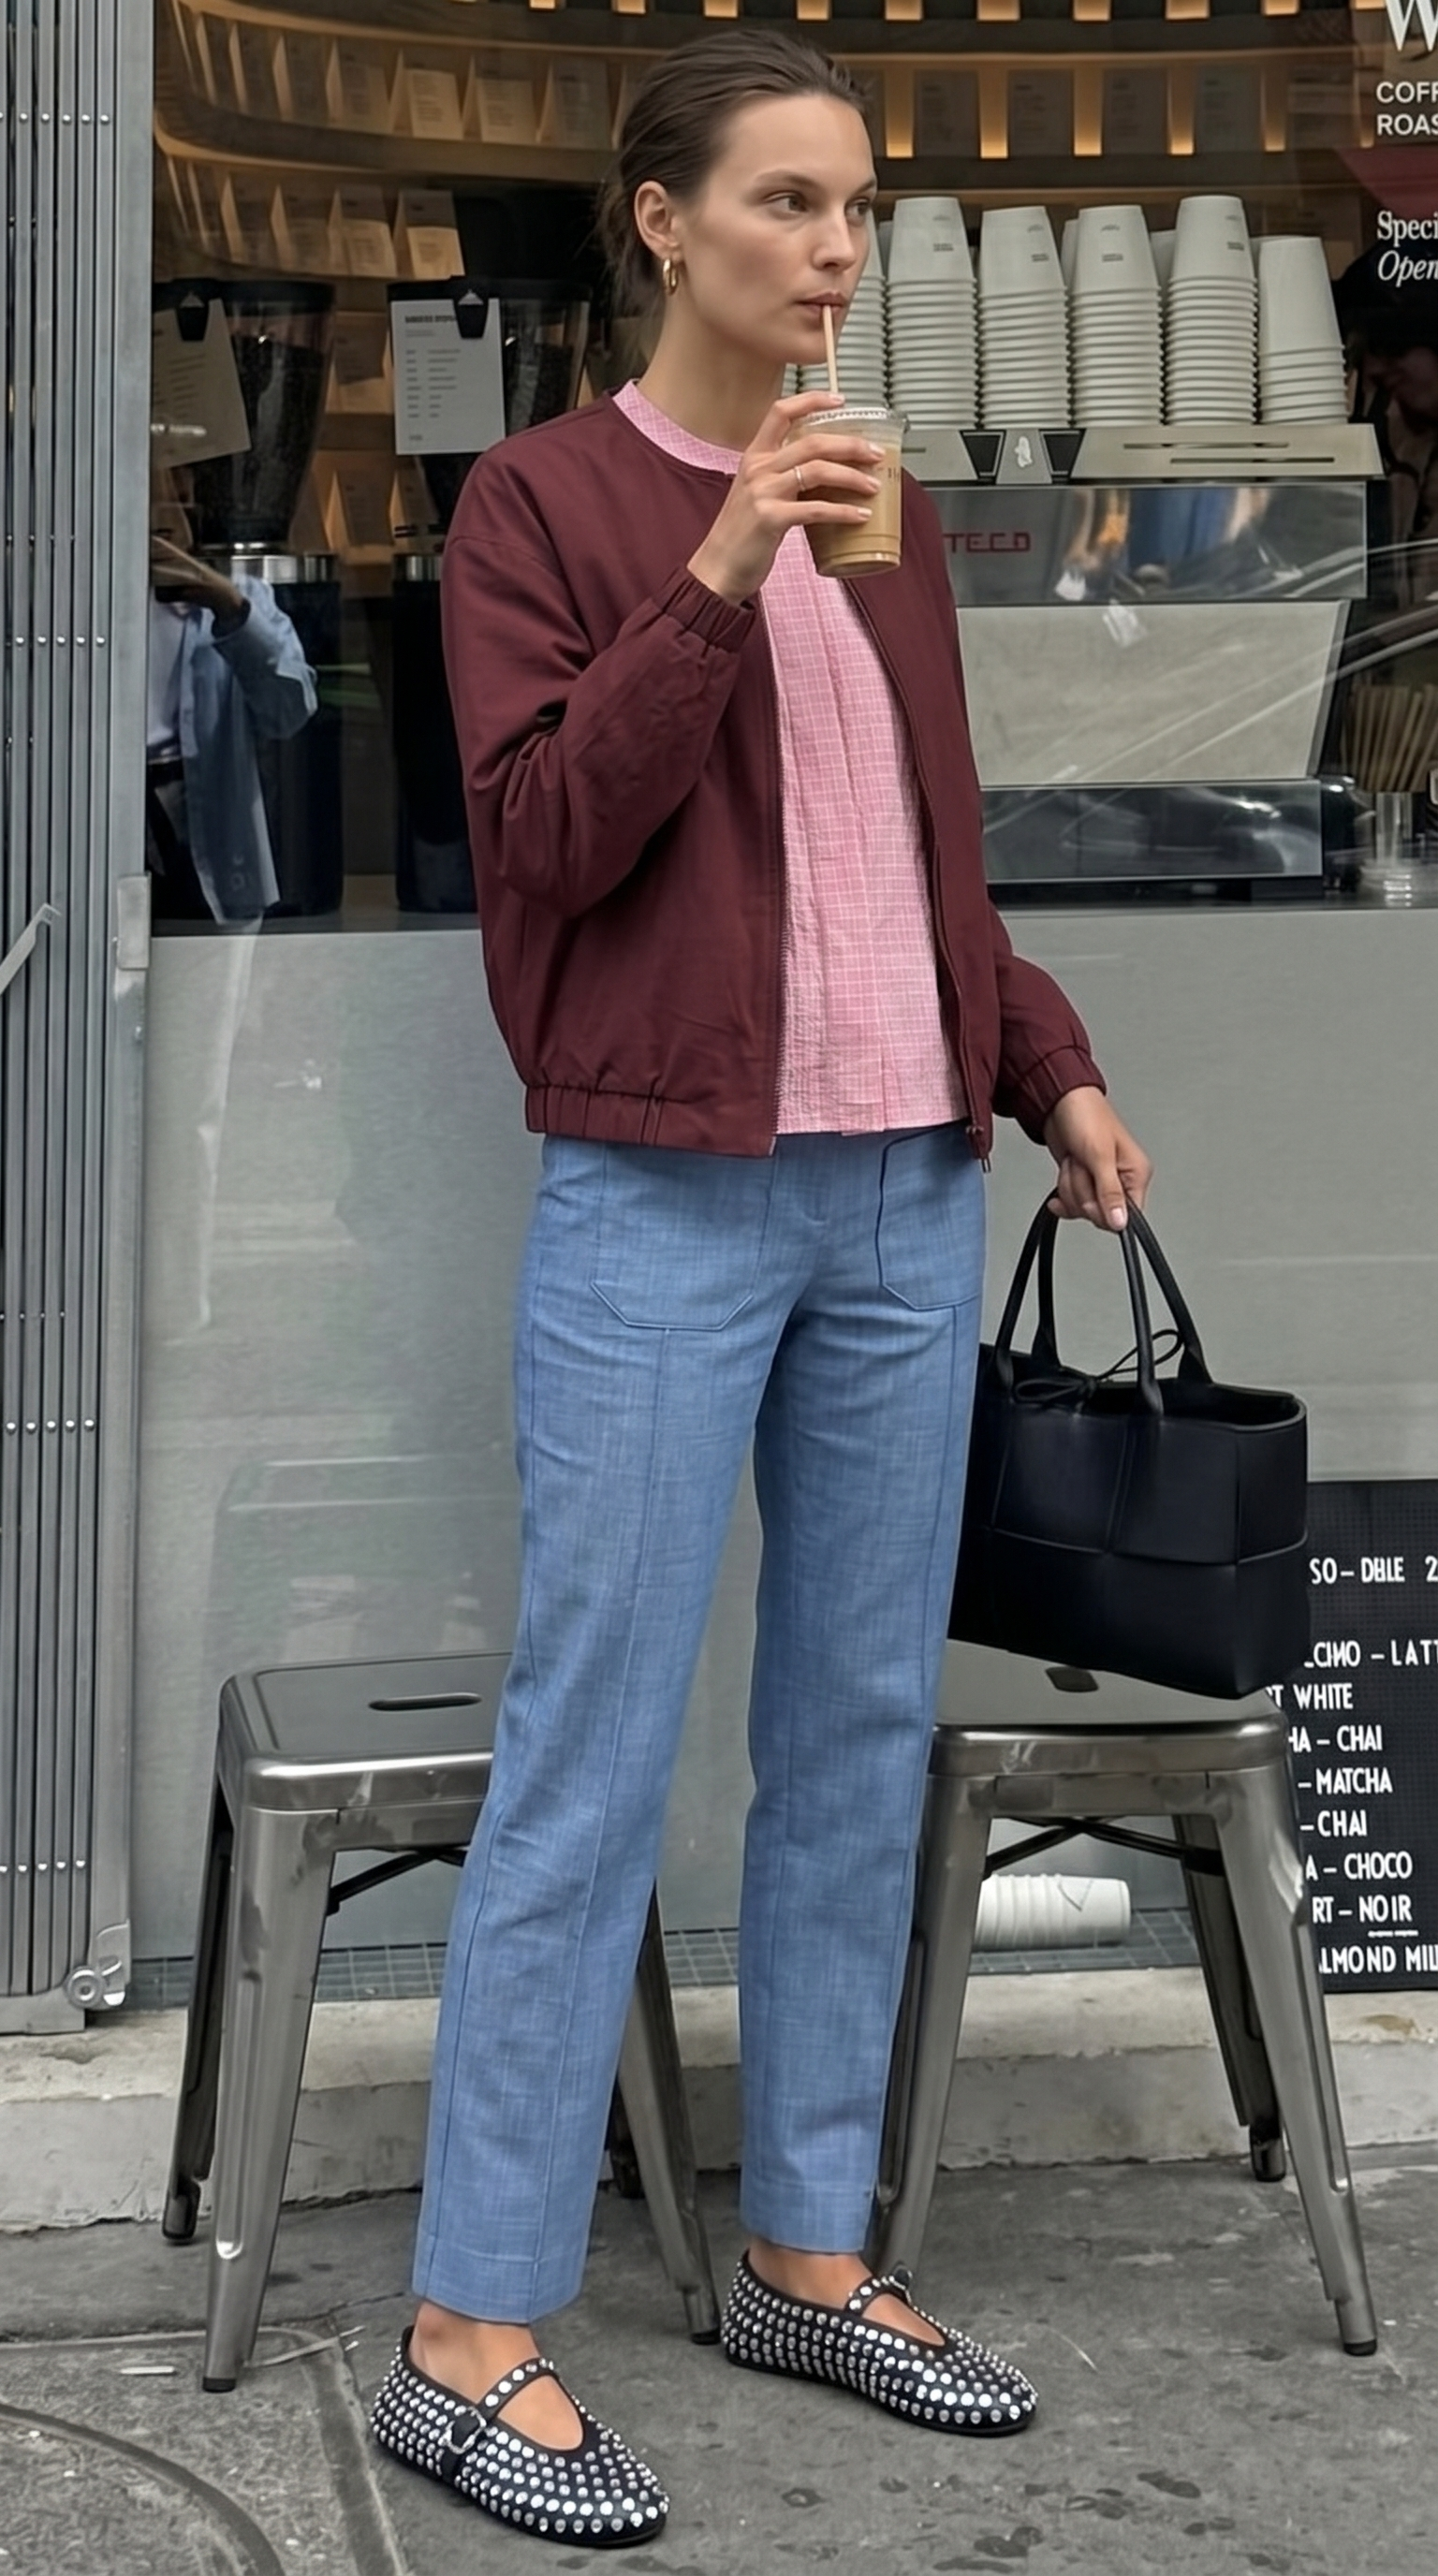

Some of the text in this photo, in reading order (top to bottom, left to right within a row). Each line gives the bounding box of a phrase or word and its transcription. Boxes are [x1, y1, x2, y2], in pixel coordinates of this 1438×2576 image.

[1303, 1640, 1361, 1669] CINO
[1292, 1682, 1354, 1710] WHITE
[1336, 1724, 1383, 1752] CHAI
[1315, 1766, 1393, 1795] MATCHA
[1317, 1809, 1368, 1837] CHAI
[1343, 1851, 1413, 1881] CHOCO
[1312, 1895, 1335, 1924] RT
[1358, 1894, 1413, 1923] NOIR
[1318, 1943, 1438, 1974] LMOND MIL
